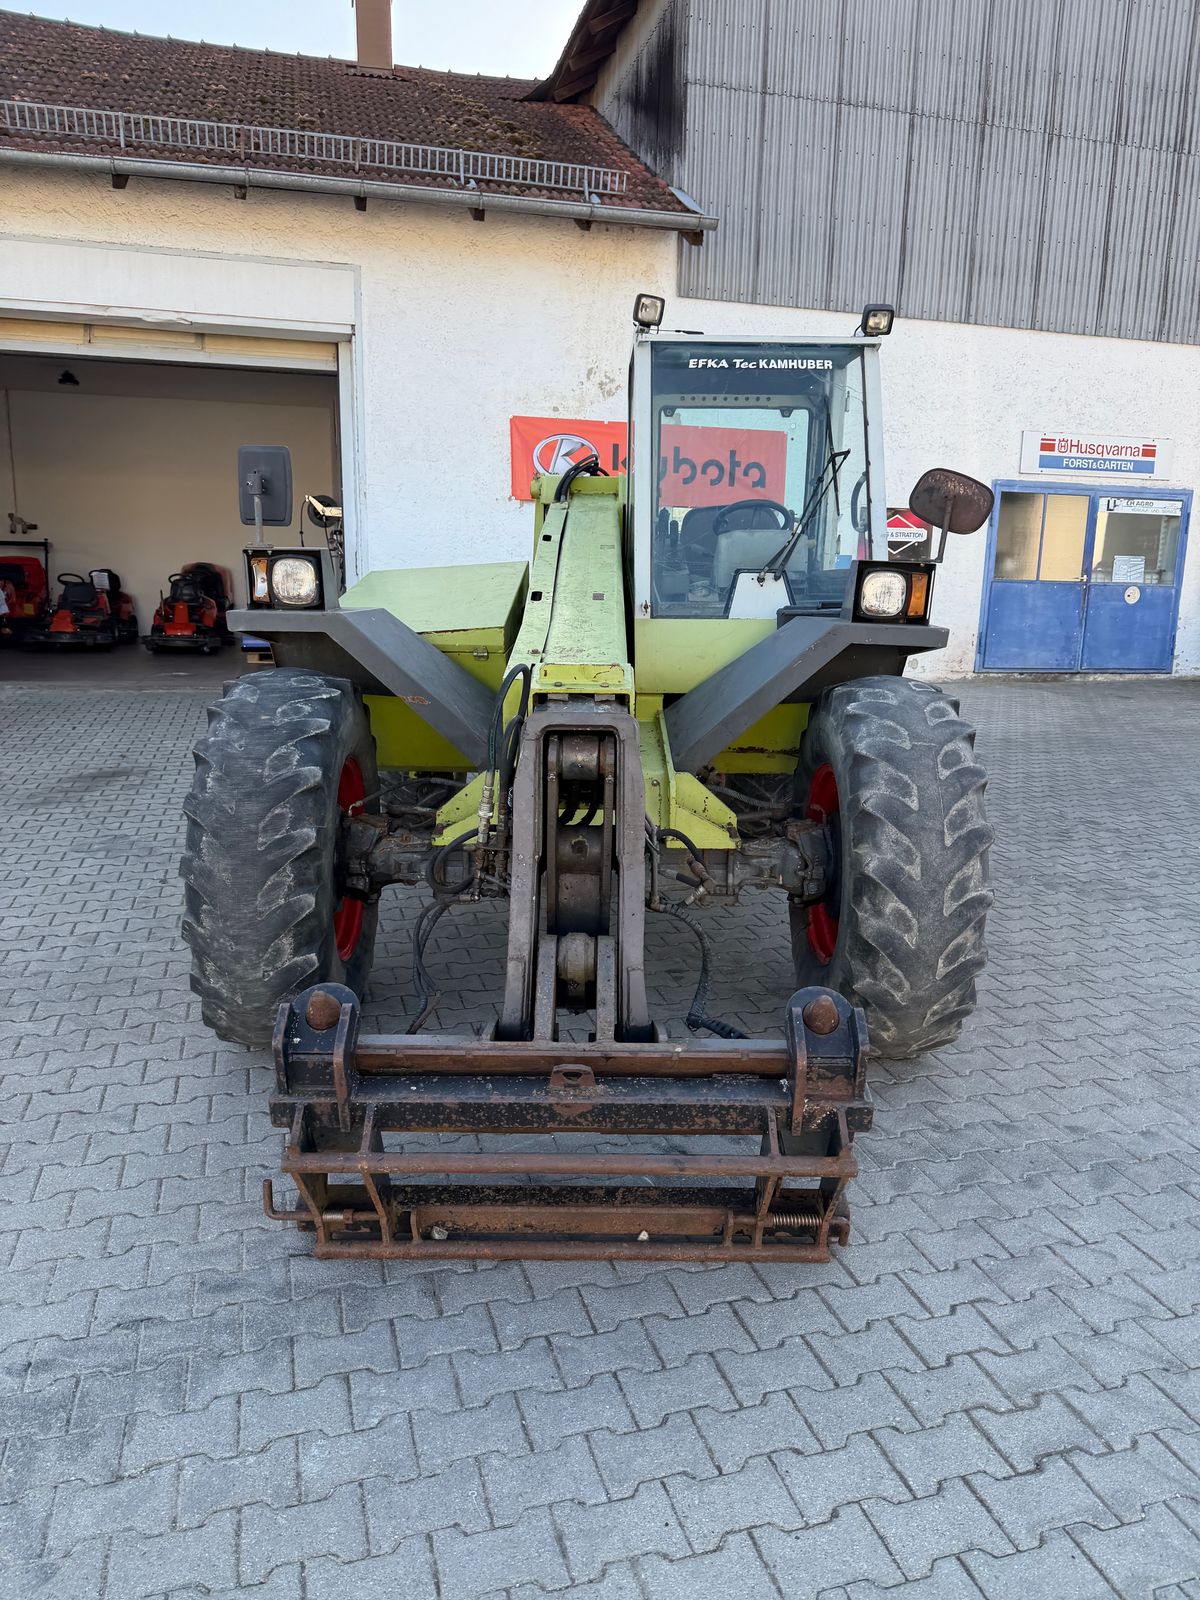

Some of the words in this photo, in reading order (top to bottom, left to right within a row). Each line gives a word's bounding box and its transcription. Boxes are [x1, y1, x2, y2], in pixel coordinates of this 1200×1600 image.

[688, 359, 729, 369] EFKA
[733, 359, 757, 369] Tec
[759, 359, 833, 370] KAMHUBER
[1070, 440, 1140, 457] Husqvarna
